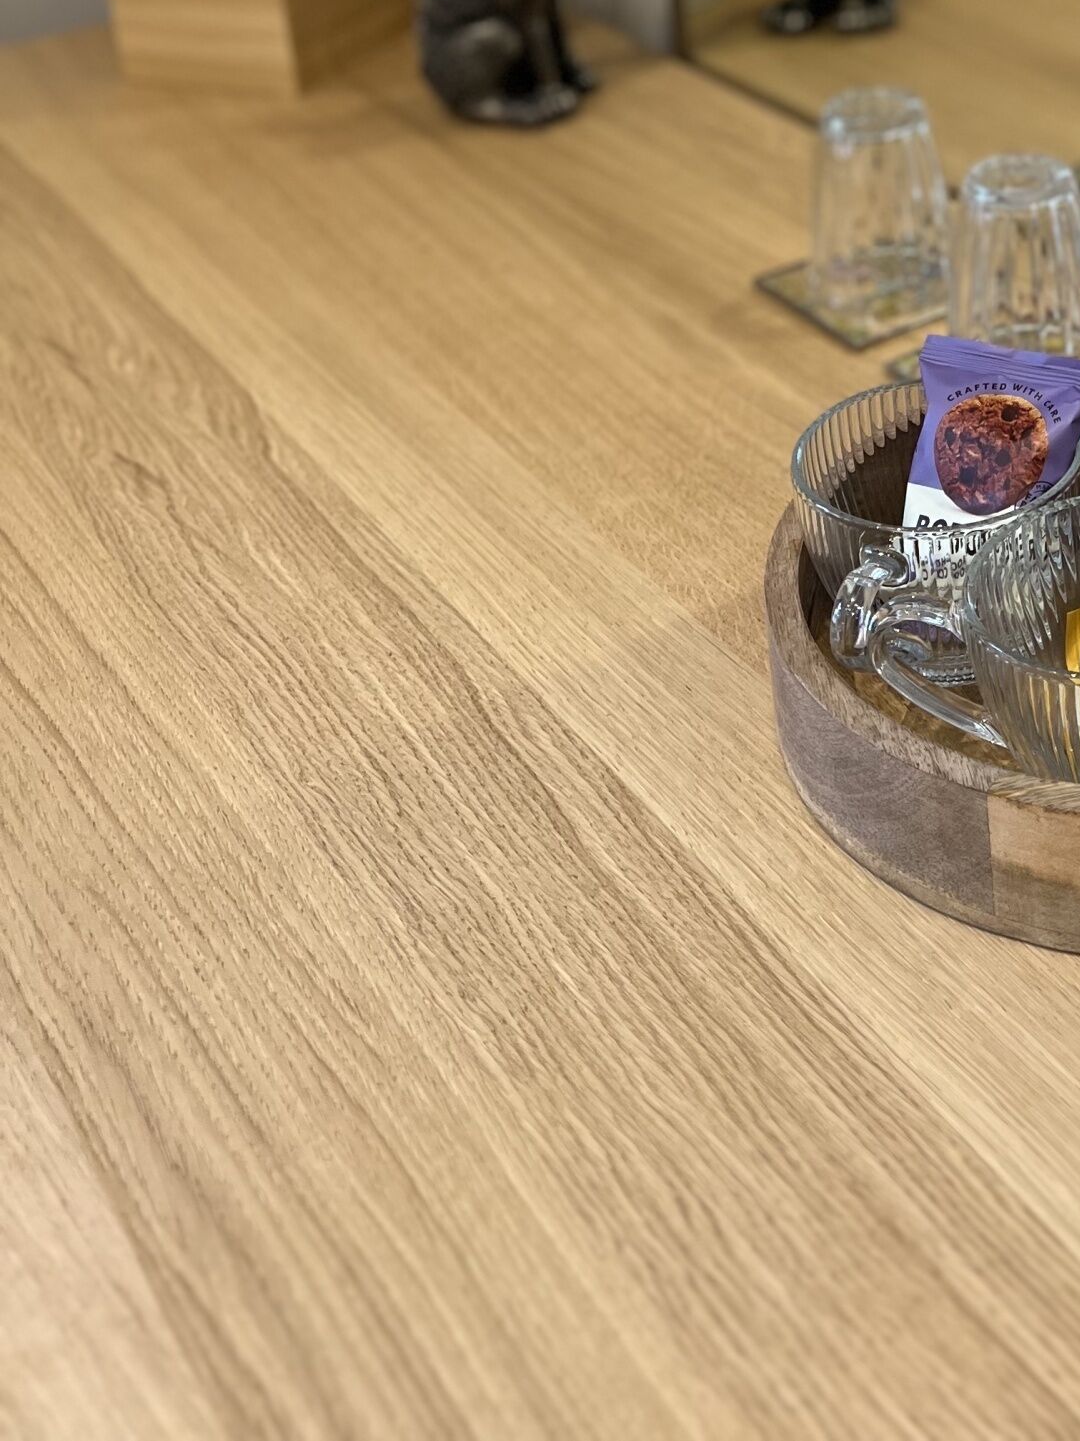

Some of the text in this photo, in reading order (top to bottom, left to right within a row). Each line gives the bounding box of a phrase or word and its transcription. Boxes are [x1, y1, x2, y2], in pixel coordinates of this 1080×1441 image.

[946, 382, 1062, 425] CRAFTED WITH CARE
